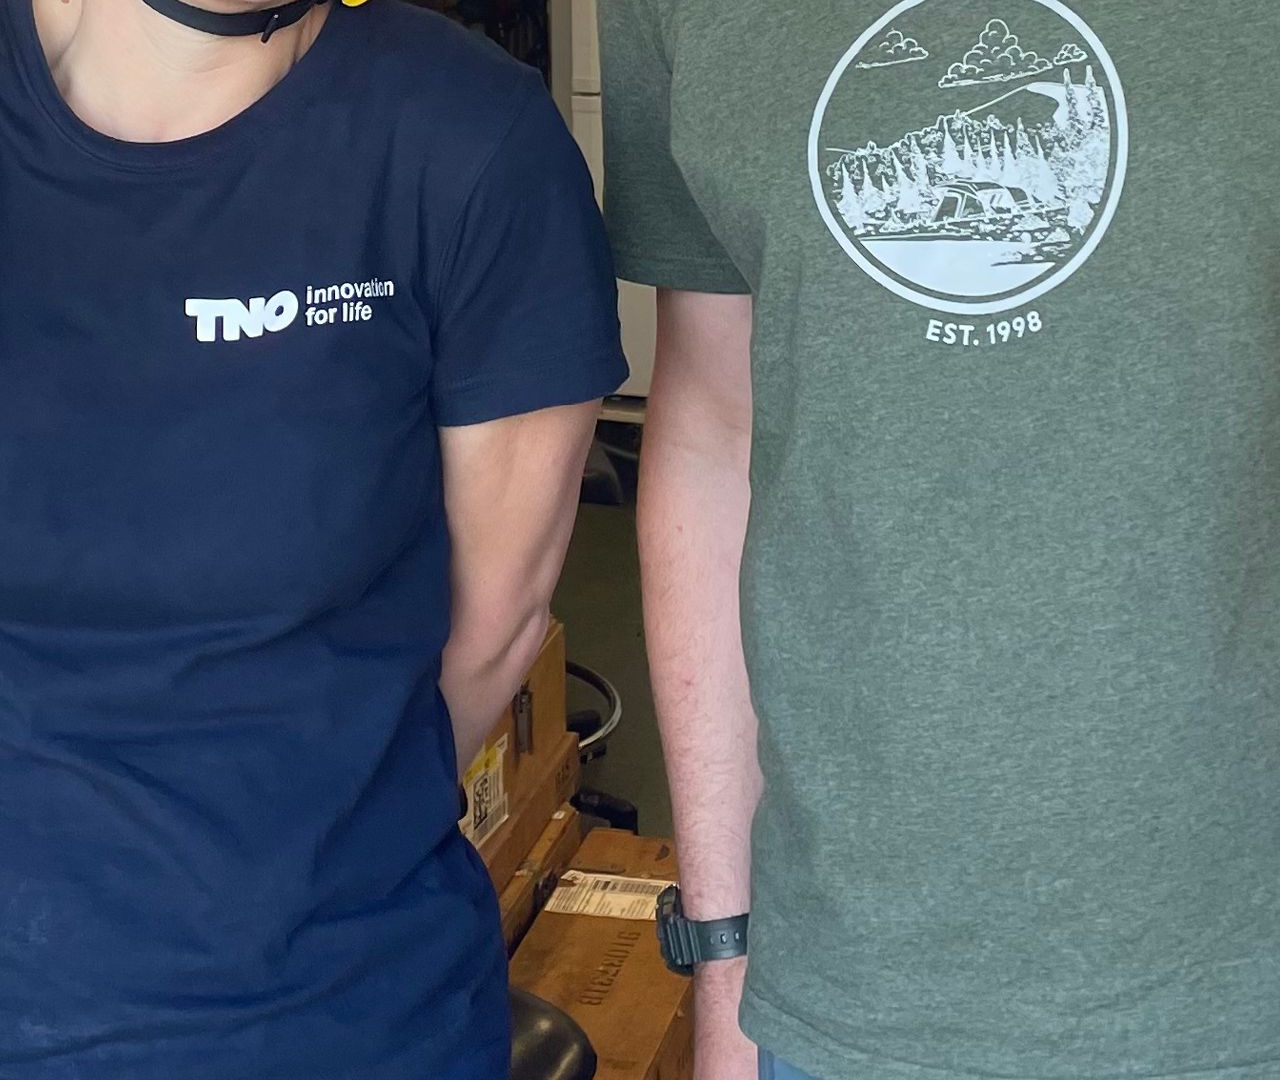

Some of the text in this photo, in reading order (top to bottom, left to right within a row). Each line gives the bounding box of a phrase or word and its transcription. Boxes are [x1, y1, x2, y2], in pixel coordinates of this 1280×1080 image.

[306, 277, 395, 305] innovation
[185, 290, 299, 342] TNO
[305, 301, 373, 327] for life
[925, 311, 1043, 346] EST. 1998
